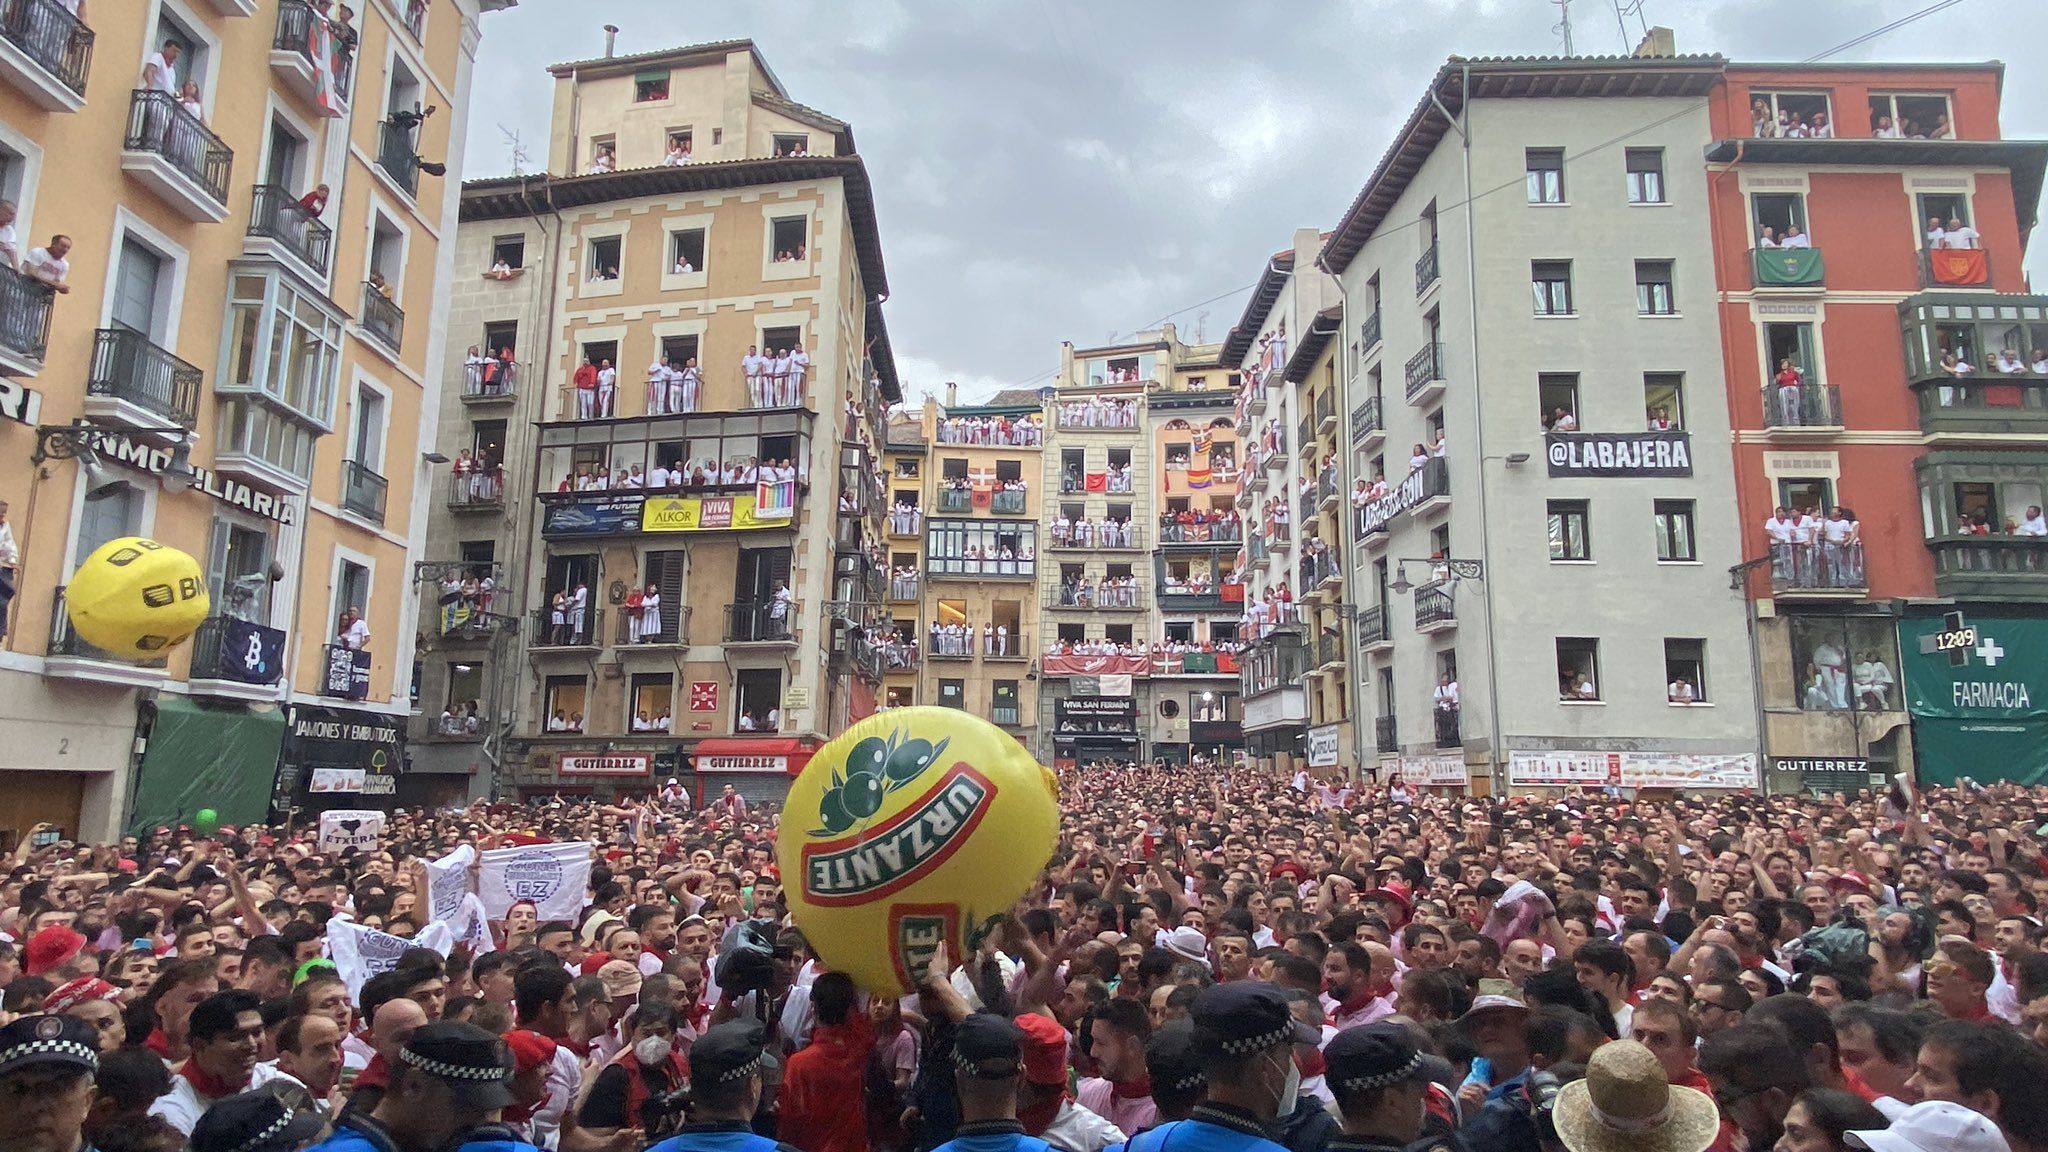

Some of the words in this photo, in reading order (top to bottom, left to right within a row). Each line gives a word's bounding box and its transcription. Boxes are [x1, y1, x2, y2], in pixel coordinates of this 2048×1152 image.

[1549, 440, 1689, 468] @LABAJERA
[654, 511, 692, 522] ALKOR
[1953, 681, 2030, 708] FARMACIA
[295, 720, 340, 739] JAMONES
[343, 724, 350, 739] Y
[351, 724, 397, 744] EMBUTIDOS
[1167, 730, 1173, 739] 2
[58, 738, 69, 755] 2
[573, 759, 636, 769] GUTIERREZ
[710, 758, 776, 768] GUTIERREZ
[1776, 760, 1868, 771] GUTIERREZ
[326, 834, 377, 845] ETXERA
[813, 783, 979, 890] URZANTE
[516, 880, 550, 898] EZ
